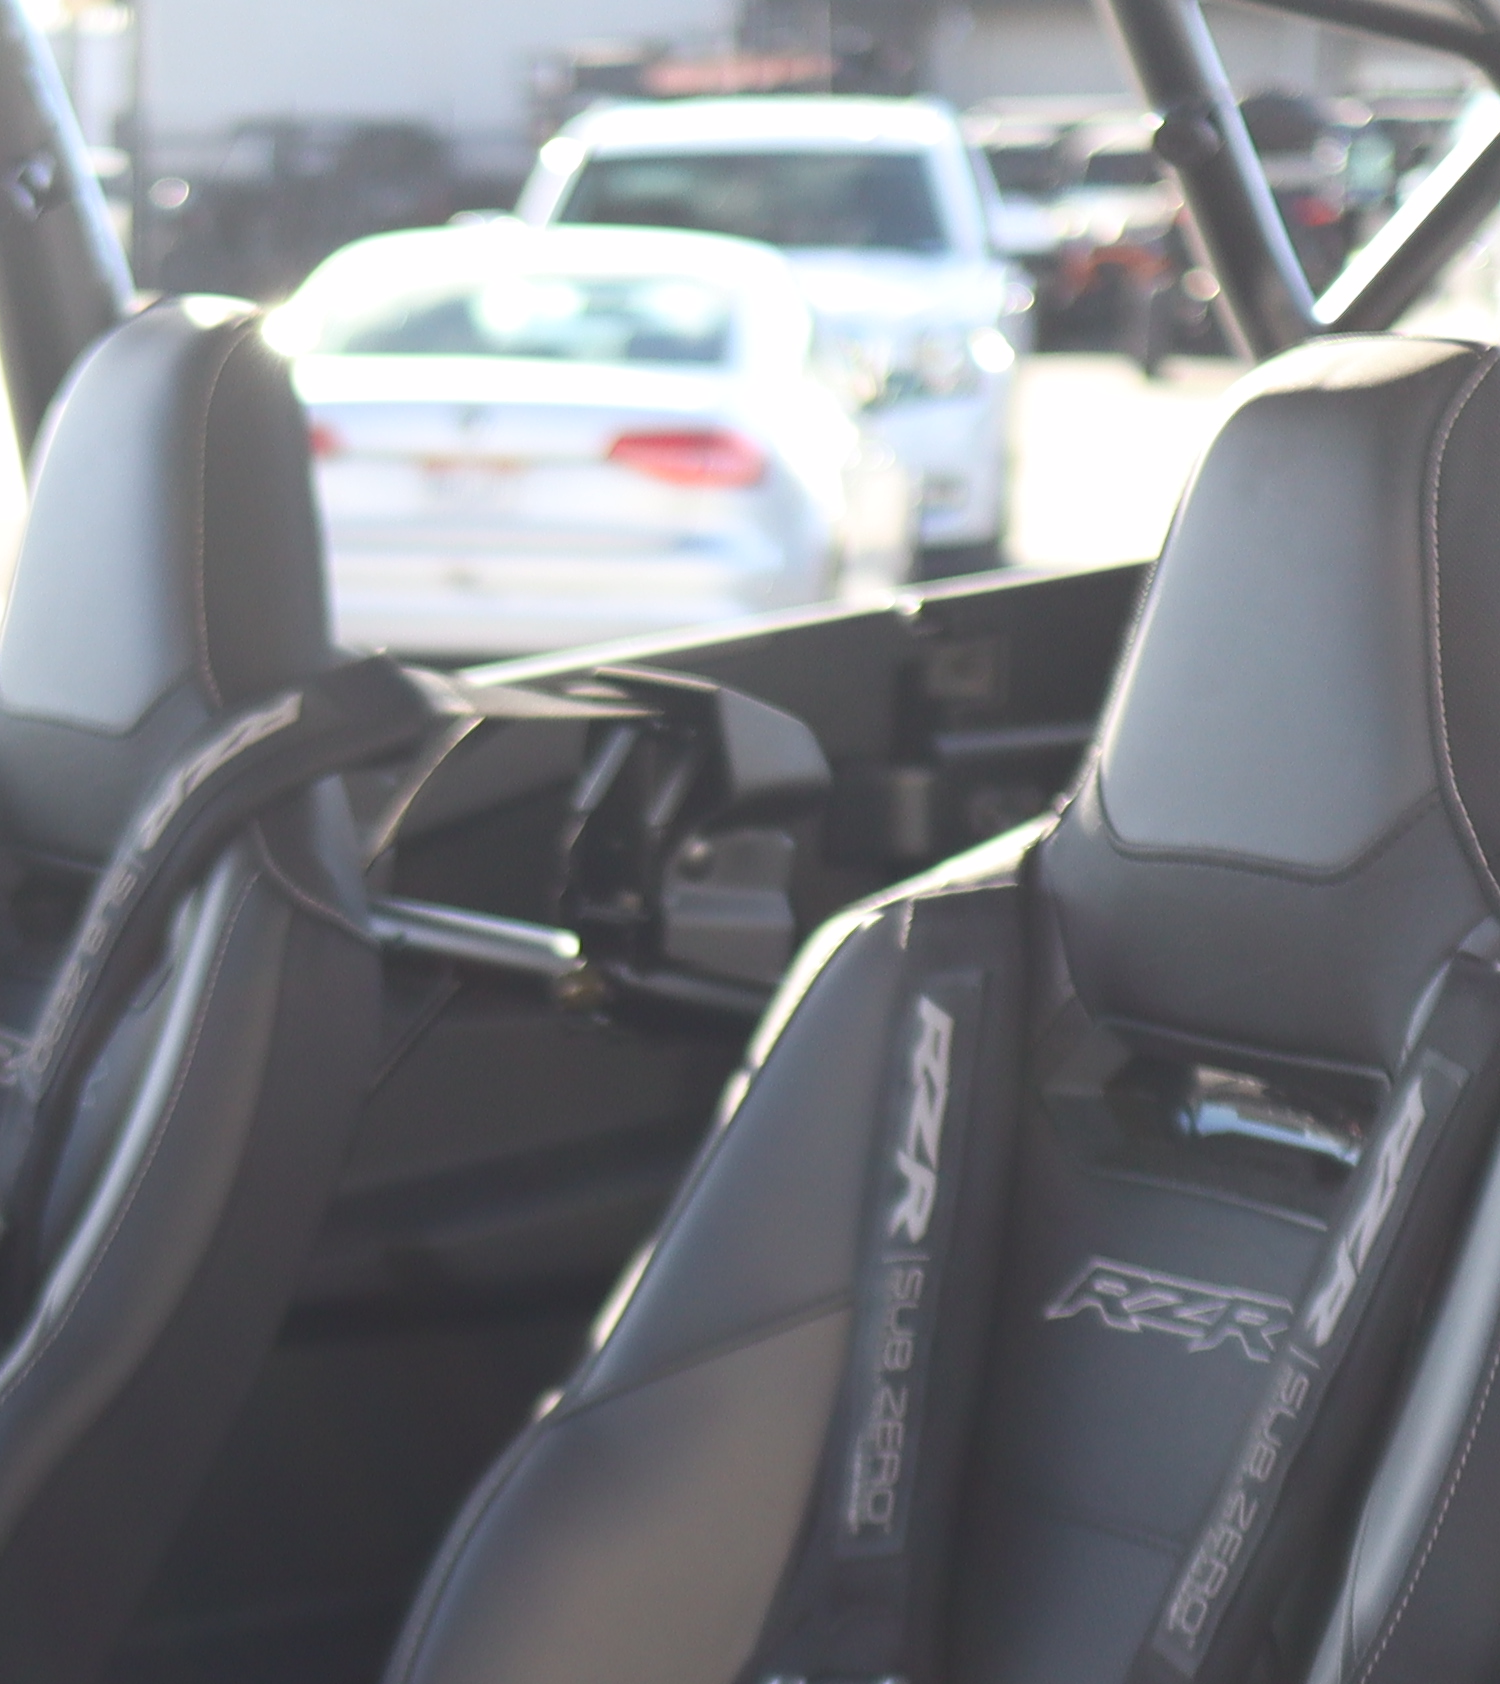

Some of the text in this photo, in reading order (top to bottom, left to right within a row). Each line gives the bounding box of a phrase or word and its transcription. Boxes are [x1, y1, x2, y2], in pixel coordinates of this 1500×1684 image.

[866, 996, 955, 1524] RZR SUB ZERO
[1303, 1077, 1427, 1349] RZR
[1045, 1255, 1294, 1364] RZR
[1244, 1362, 1310, 1483] SUB
[1180, 1490, 1259, 1636] ZERO
